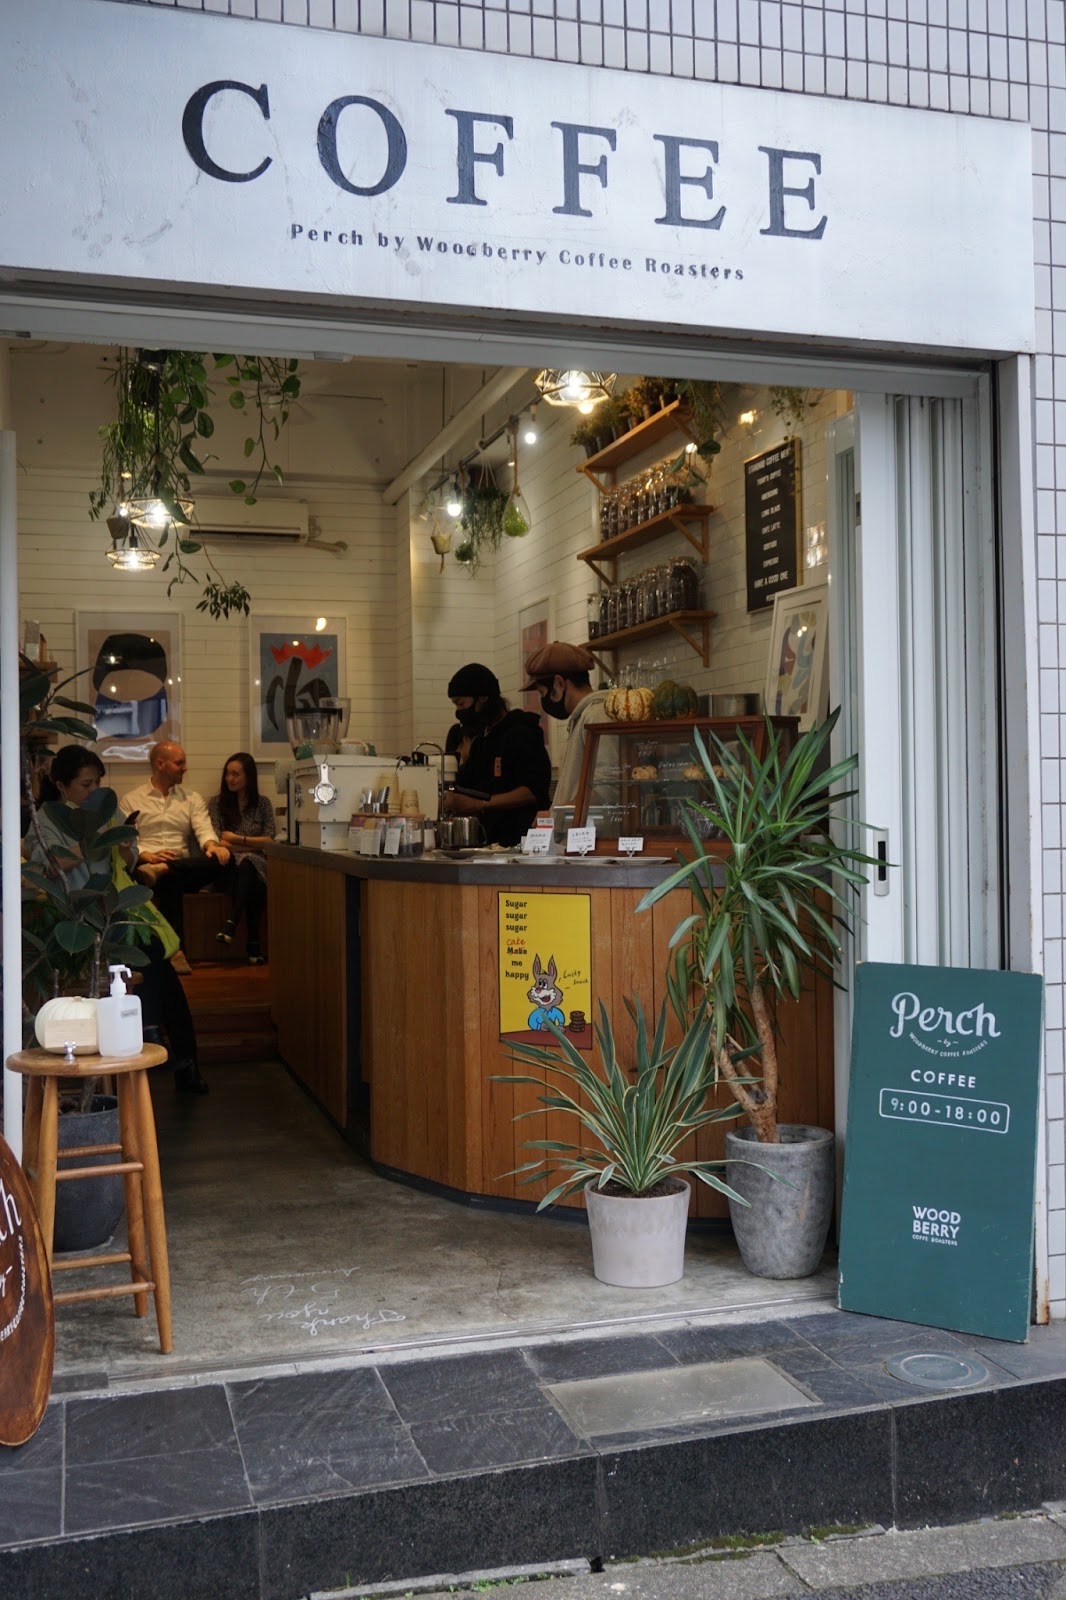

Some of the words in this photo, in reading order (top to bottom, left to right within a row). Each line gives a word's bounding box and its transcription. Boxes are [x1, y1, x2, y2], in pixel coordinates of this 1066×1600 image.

[181, 80, 829, 240] COFFEE
[291, 223, 363, 246] Perch
[377, 232, 405, 253] by
[558, 249, 633, 270] Coffee
[645, 257, 745, 281] Roasters
[754, 576, 764, 589] HAVE
[768, 572, 779, 584] GOOD
[779, 570, 789, 582] ONE
[506, 900, 527, 909] Sugar
[506, 912, 527, 921] sugar
[506, 924, 527, 933] sugar
[505, 970, 529, 981] happy
[889, 991, 1001, 1038] Perch
[911, 1069, 976, 1089] COFFEE
[890, 1097, 1001, 1125] 9:00-18:00
[912, 1205, 961, 1225] WOOD
[913, 1220, 960, 1239] BERRY
[258, 1302, 329, 1321] you
[290, 1309, 406, 1336] Thank
